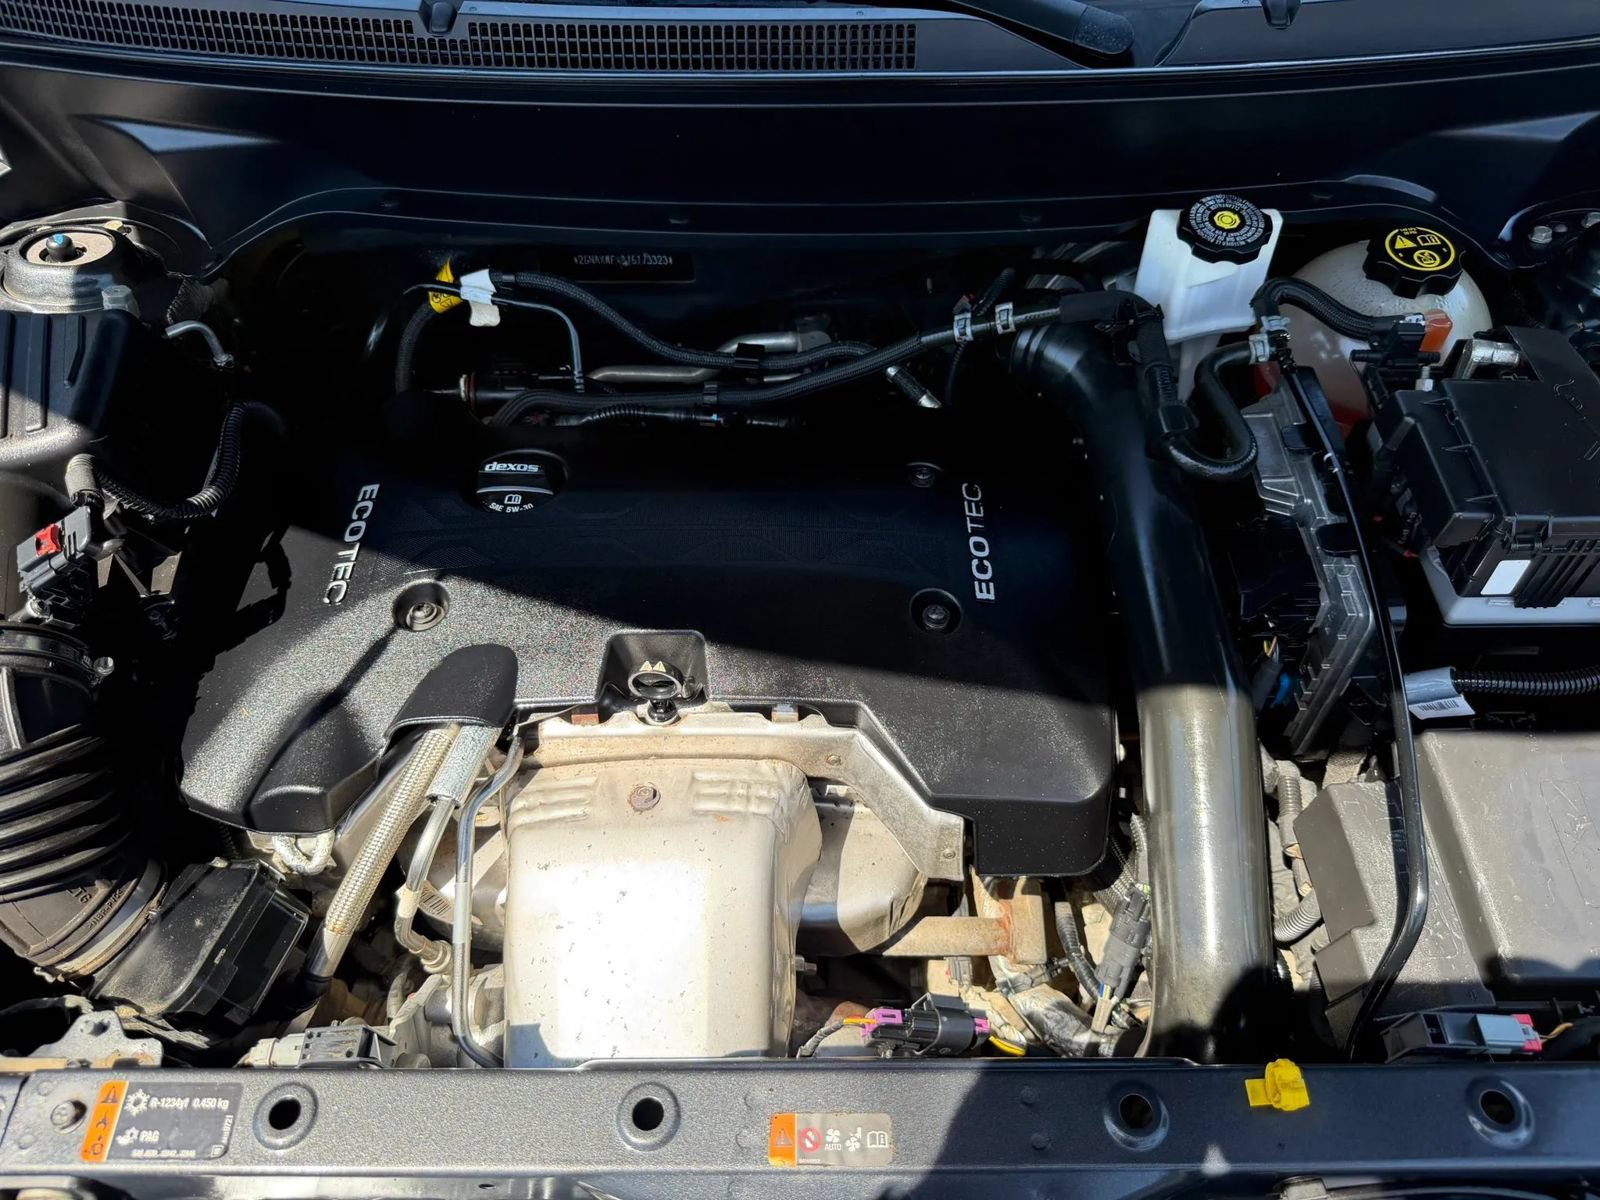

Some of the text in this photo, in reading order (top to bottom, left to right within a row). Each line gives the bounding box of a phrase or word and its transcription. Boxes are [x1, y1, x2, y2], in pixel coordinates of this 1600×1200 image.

[484, 461, 539, 472] dexos
[488, 502, 504, 512] SAE
[323, 483, 380, 605] ECOTEC
[961, 483, 995, 600] ECOTEC
[192, 1097, 216, 1109] 0.450
[217, 1098, 229, 1110] kg
[139, 1130, 160, 1143] PAG
[824, 1143, 842, 1151] AUTO
